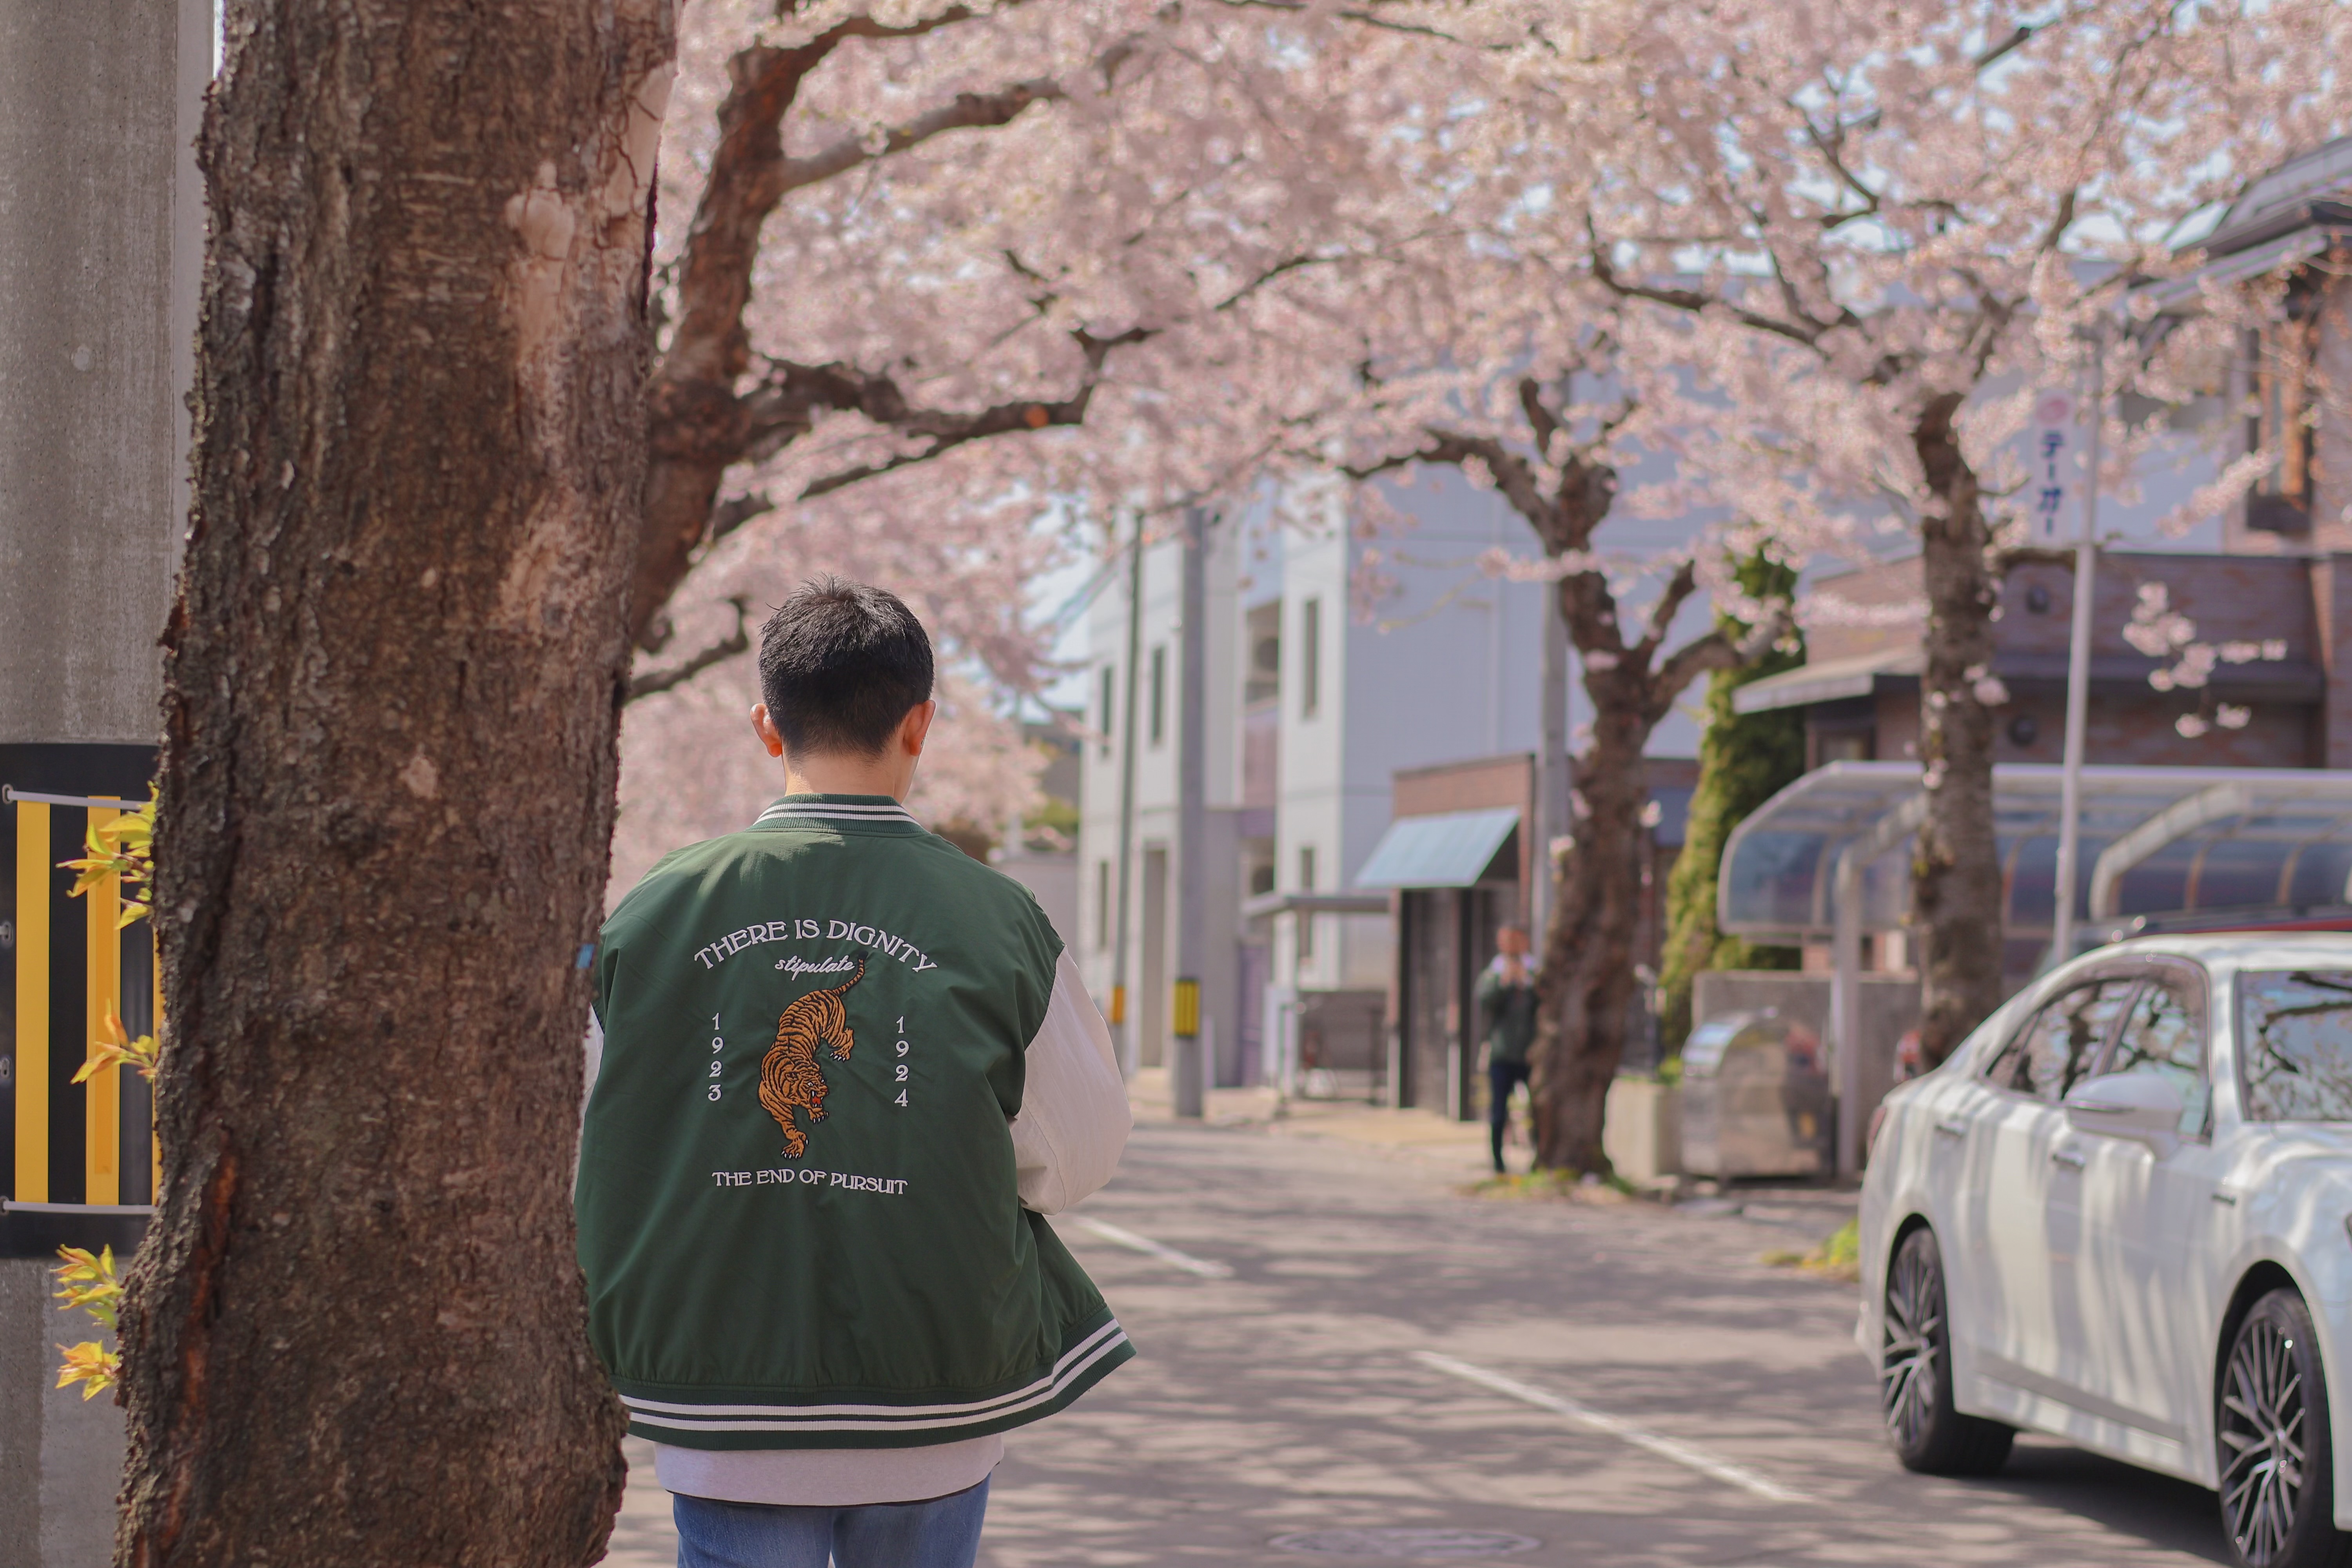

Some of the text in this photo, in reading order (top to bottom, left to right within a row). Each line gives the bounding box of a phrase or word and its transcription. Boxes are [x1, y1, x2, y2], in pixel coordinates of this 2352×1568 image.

[694, 919, 938, 973] THERE IS DIGNITY
[774, 955, 855, 981] stipulate
[708, 1012, 724, 1102] 1923
[894, 1015, 910, 1107] 1924
[711, 1168, 908, 1195] THE END OF PURSUIT
